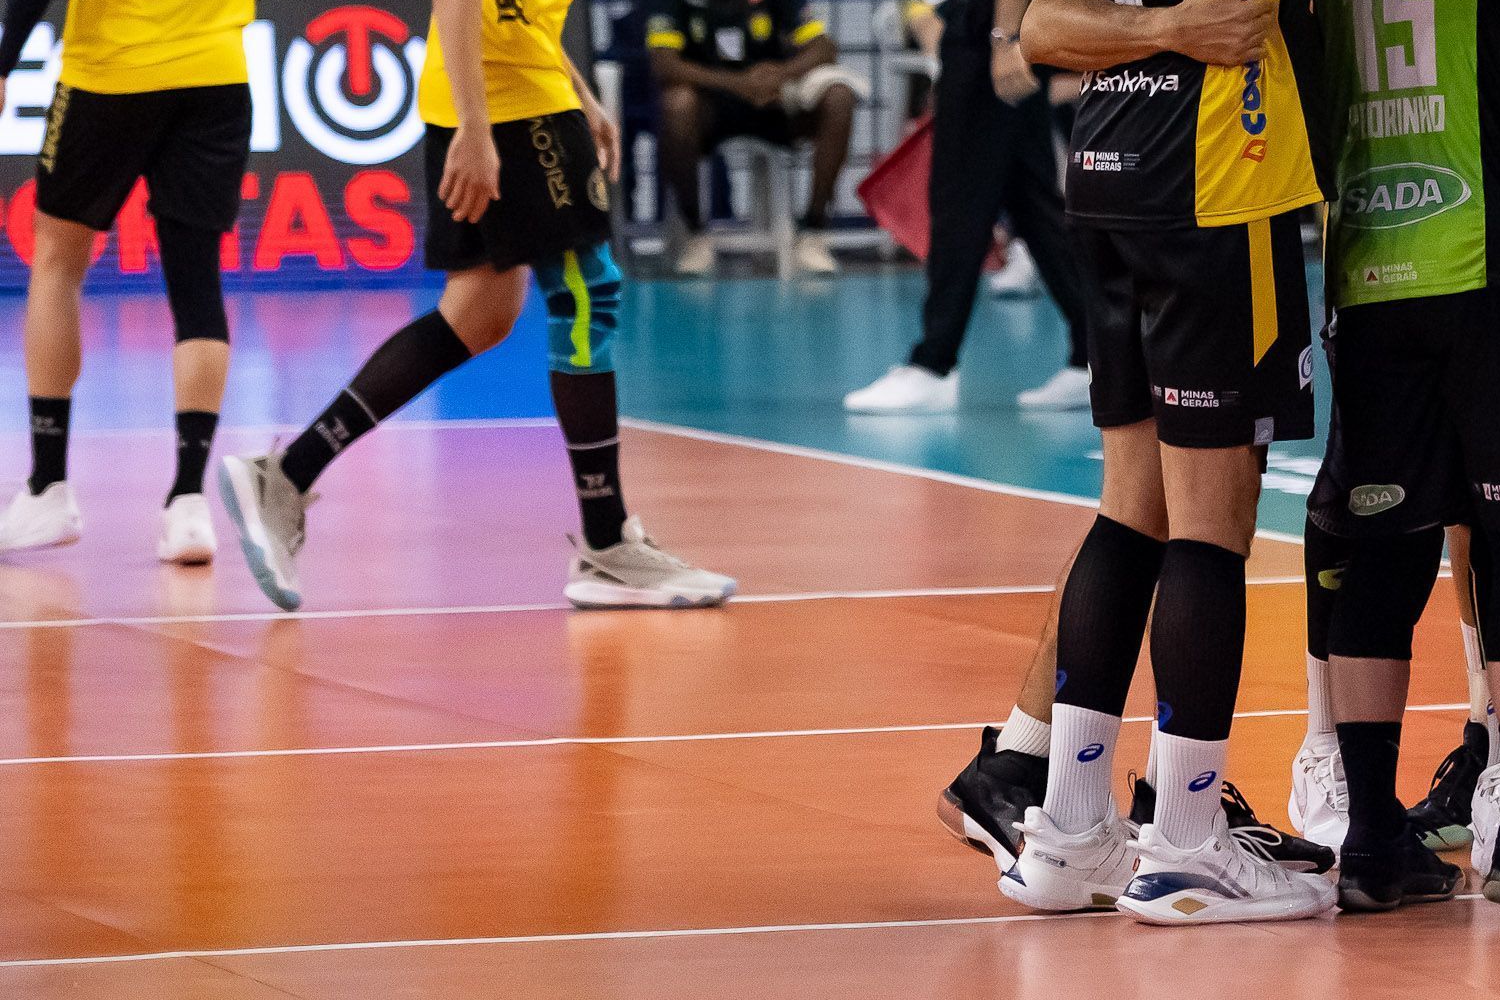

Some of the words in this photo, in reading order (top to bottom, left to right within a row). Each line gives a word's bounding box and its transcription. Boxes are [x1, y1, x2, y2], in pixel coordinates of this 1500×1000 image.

[1095, 152, 1119, 161] MINAS
[1094, 161, 1122, 171] GERAIS
[1346, 179, 1444, 214] SADA
[1181, 390, 1214, 399] MINAS
[1181, 399, 1220, 408] GERAIS
